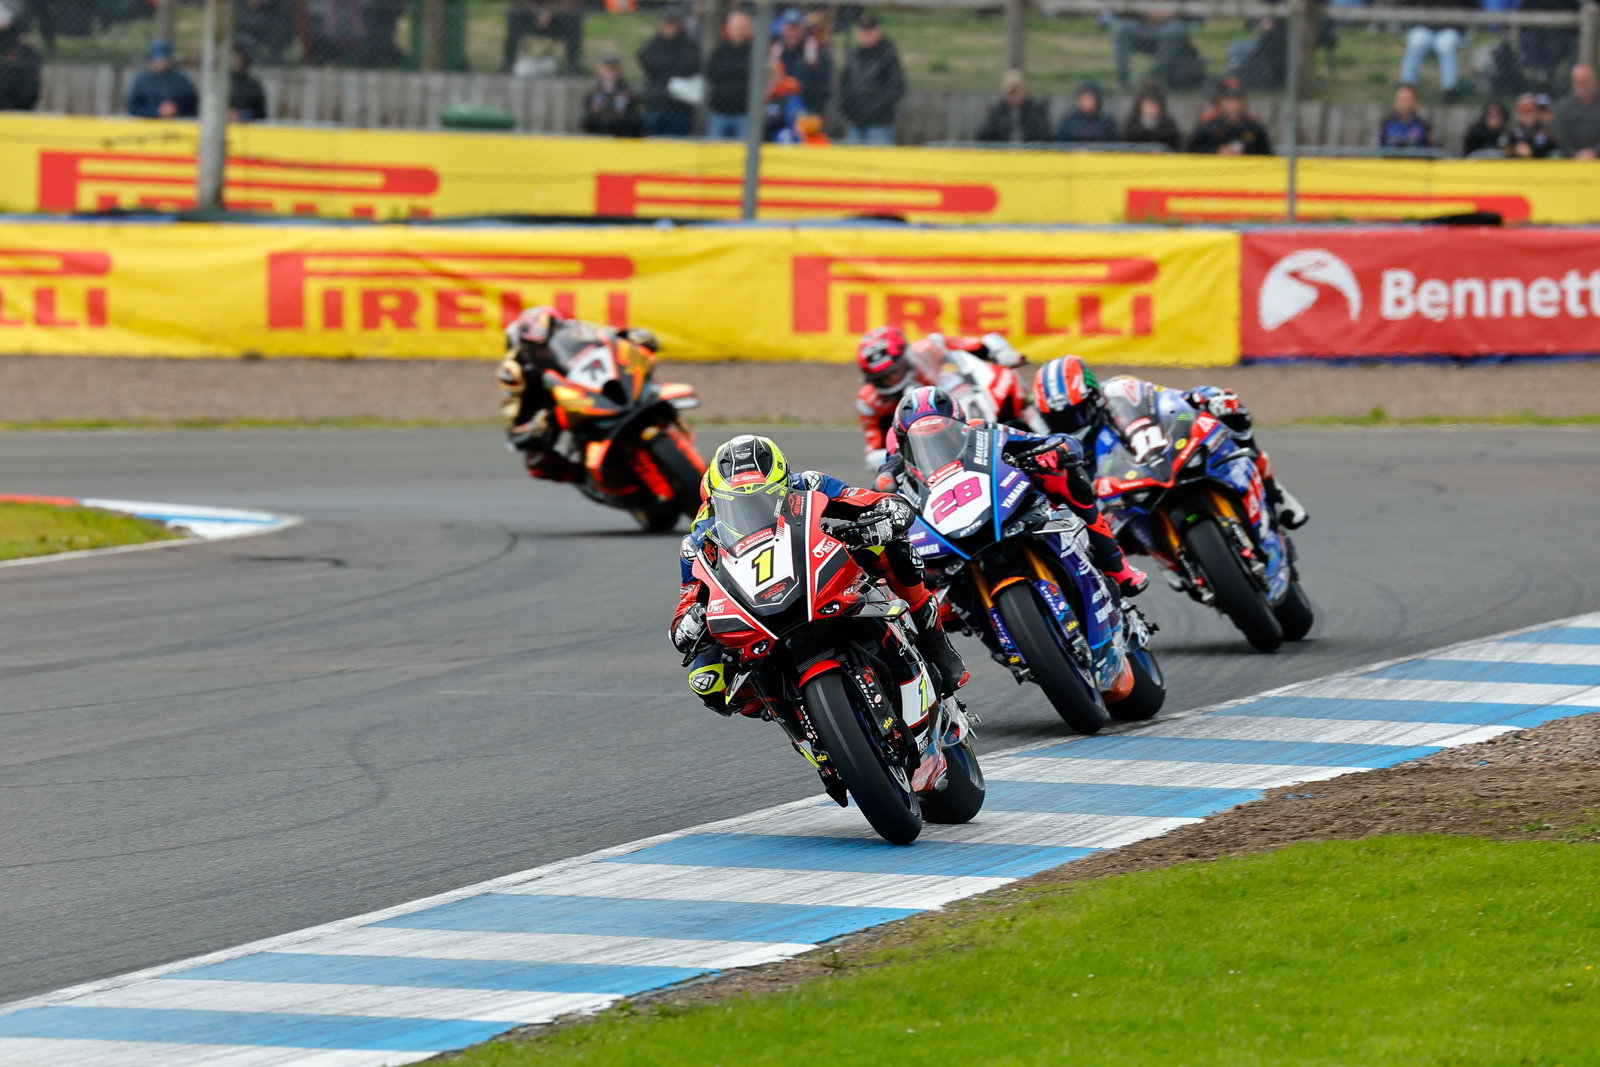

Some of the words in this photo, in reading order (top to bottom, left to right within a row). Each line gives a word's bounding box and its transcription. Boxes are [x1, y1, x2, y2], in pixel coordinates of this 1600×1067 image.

[792, 255, 1159, 338] PIRELLI
[930, 476, 982, 524] 28
[1001, 480, 1031, 510] YAMAHA
[751, 545, 775, 587] 1
[812, 537, 838, 558] OMG
[706, 598, 729, 614] OMG
[918, 674, 928, 716] 1
